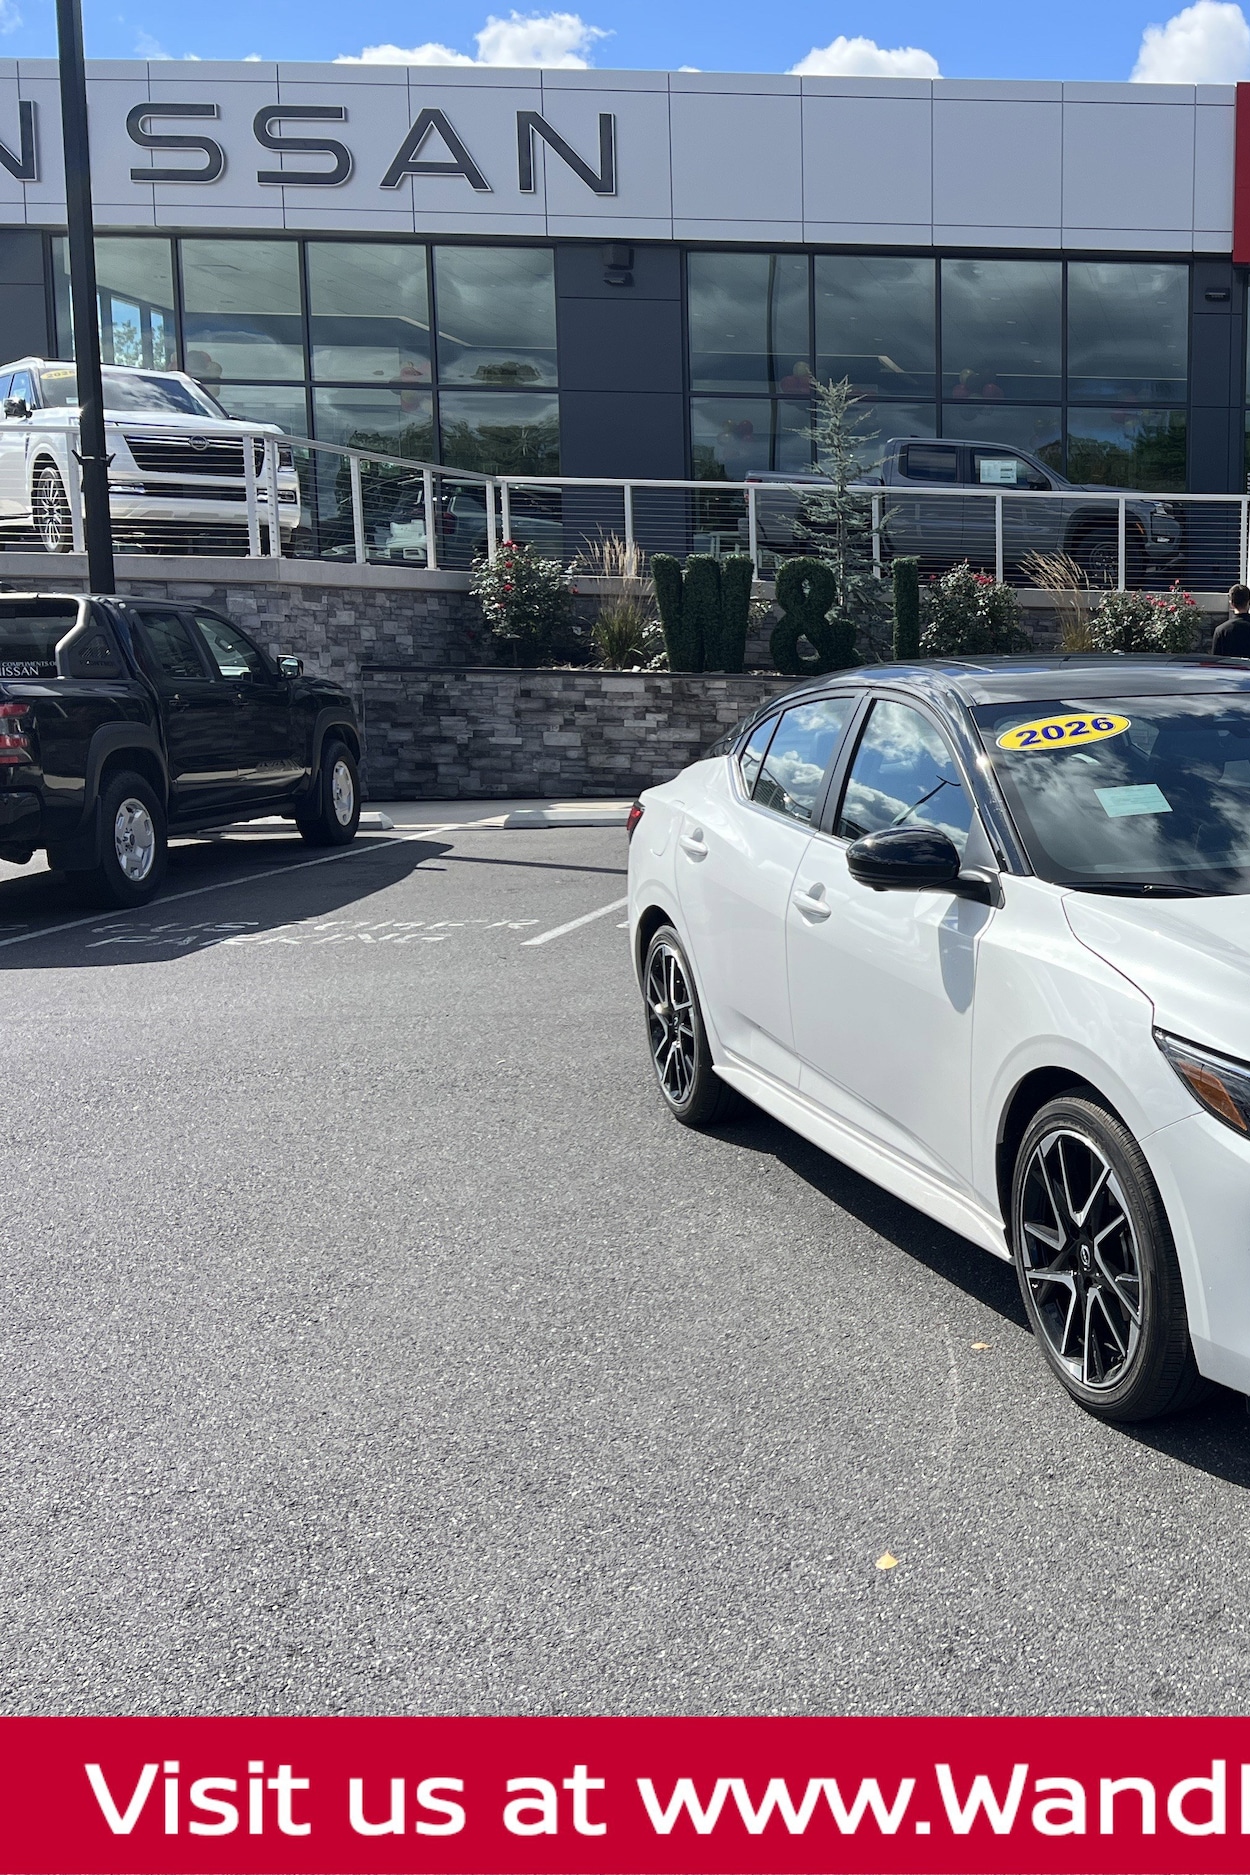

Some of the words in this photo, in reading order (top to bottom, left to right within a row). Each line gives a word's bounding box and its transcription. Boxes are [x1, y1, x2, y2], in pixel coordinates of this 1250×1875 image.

[0, 99, 618, 196] SSAN
[0, 666, 39, 677] ISSAN
[1015, 717, 1116, 747] 2026
